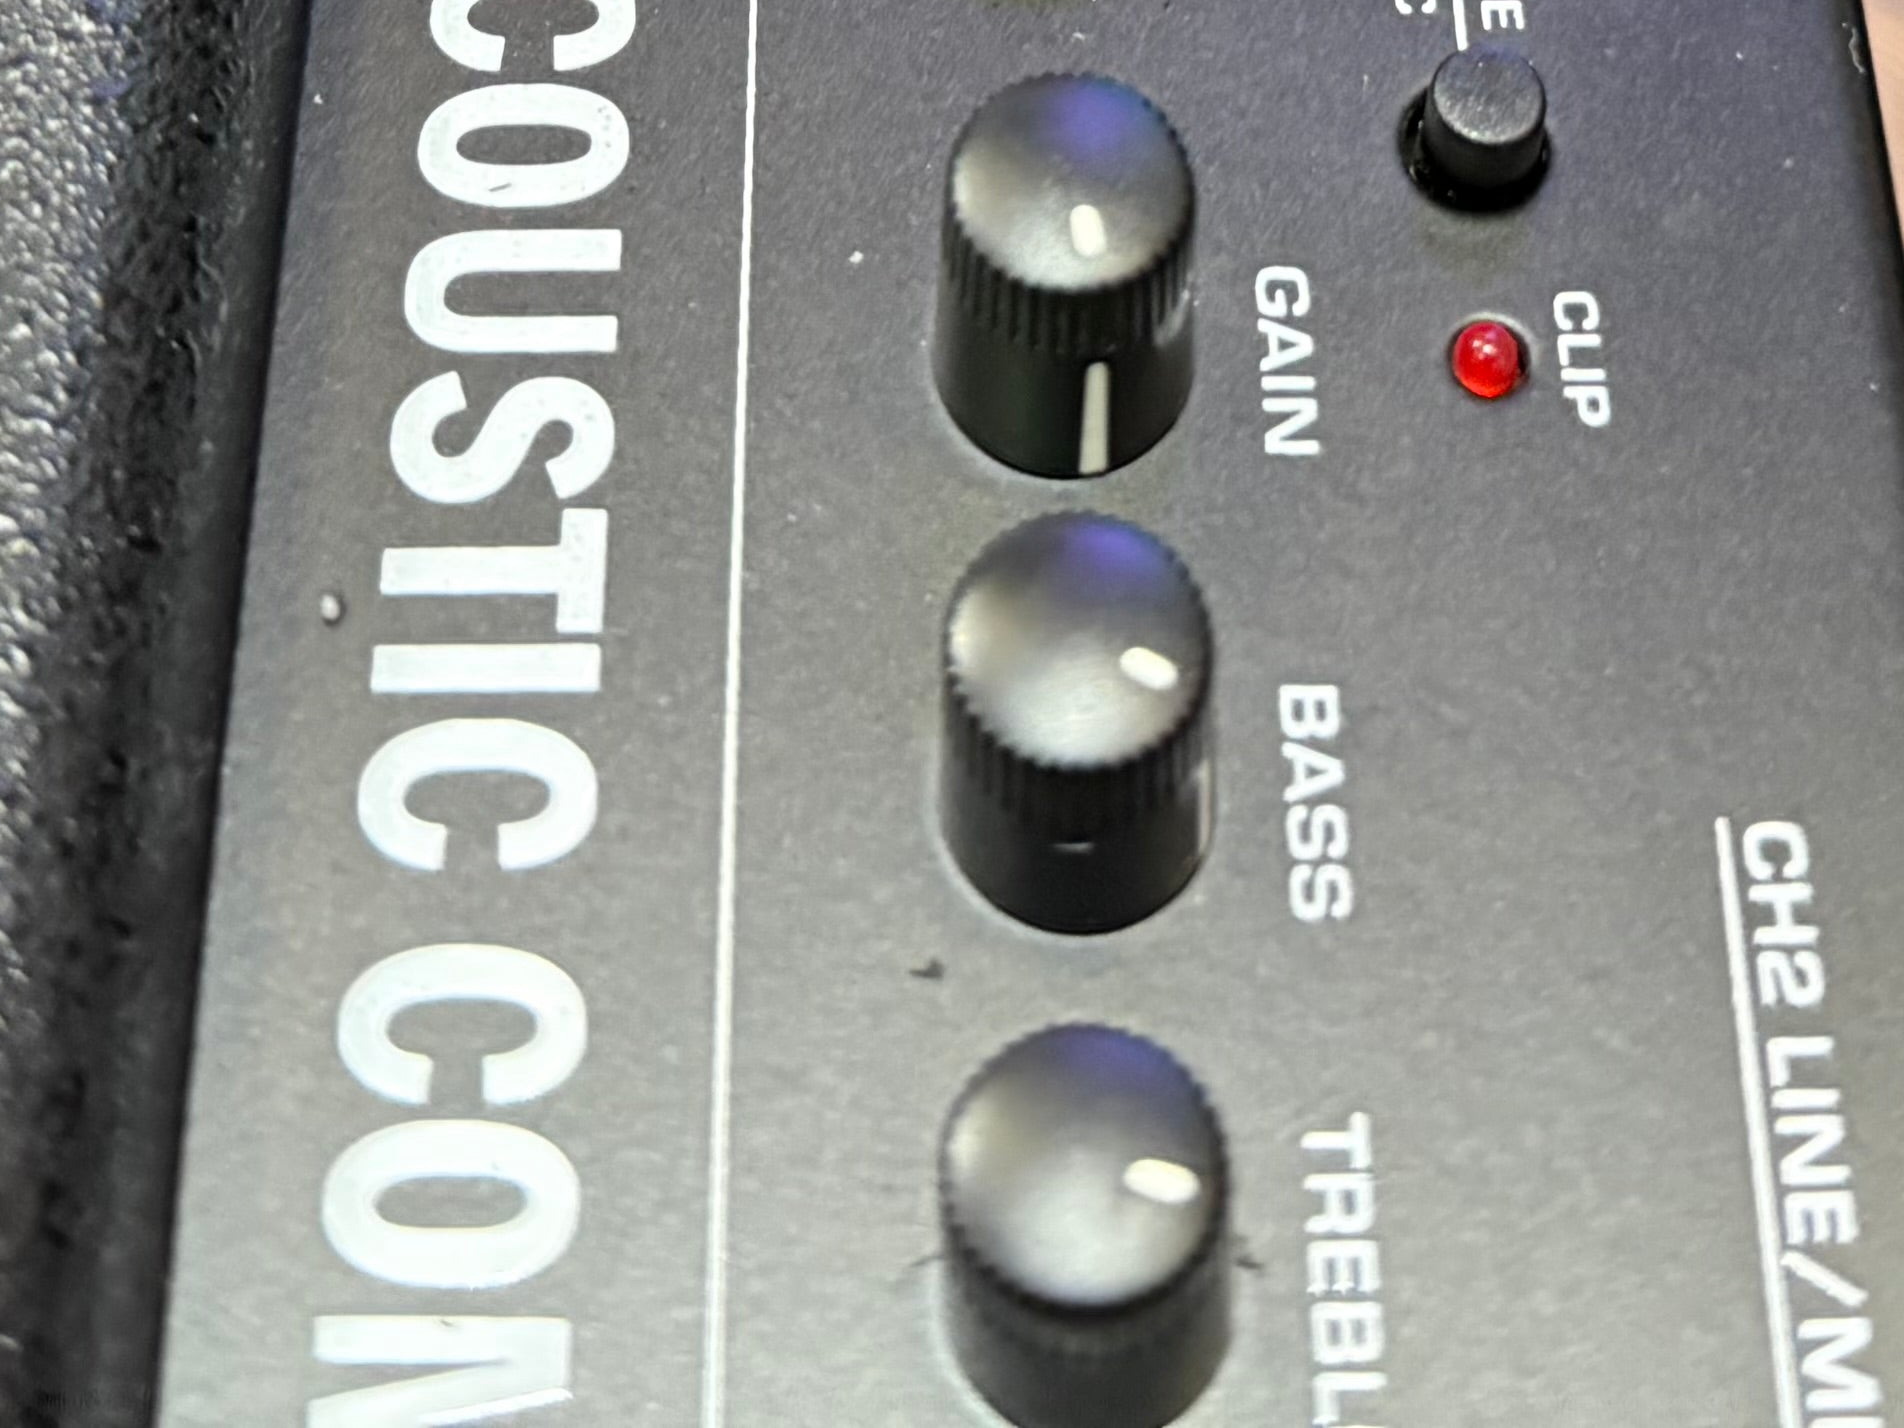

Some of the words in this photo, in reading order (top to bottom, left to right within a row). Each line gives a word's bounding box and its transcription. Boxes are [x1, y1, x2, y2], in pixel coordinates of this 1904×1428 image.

[1254, 265, 1321, 456] GAIN
[1552, 290, 1612, 429] CLIP
[1278, 684, 1354, 922] BASS
[1741, 820, 1826, 1009] CH2
[1300, 1110, 1388, 1428] TREBL
